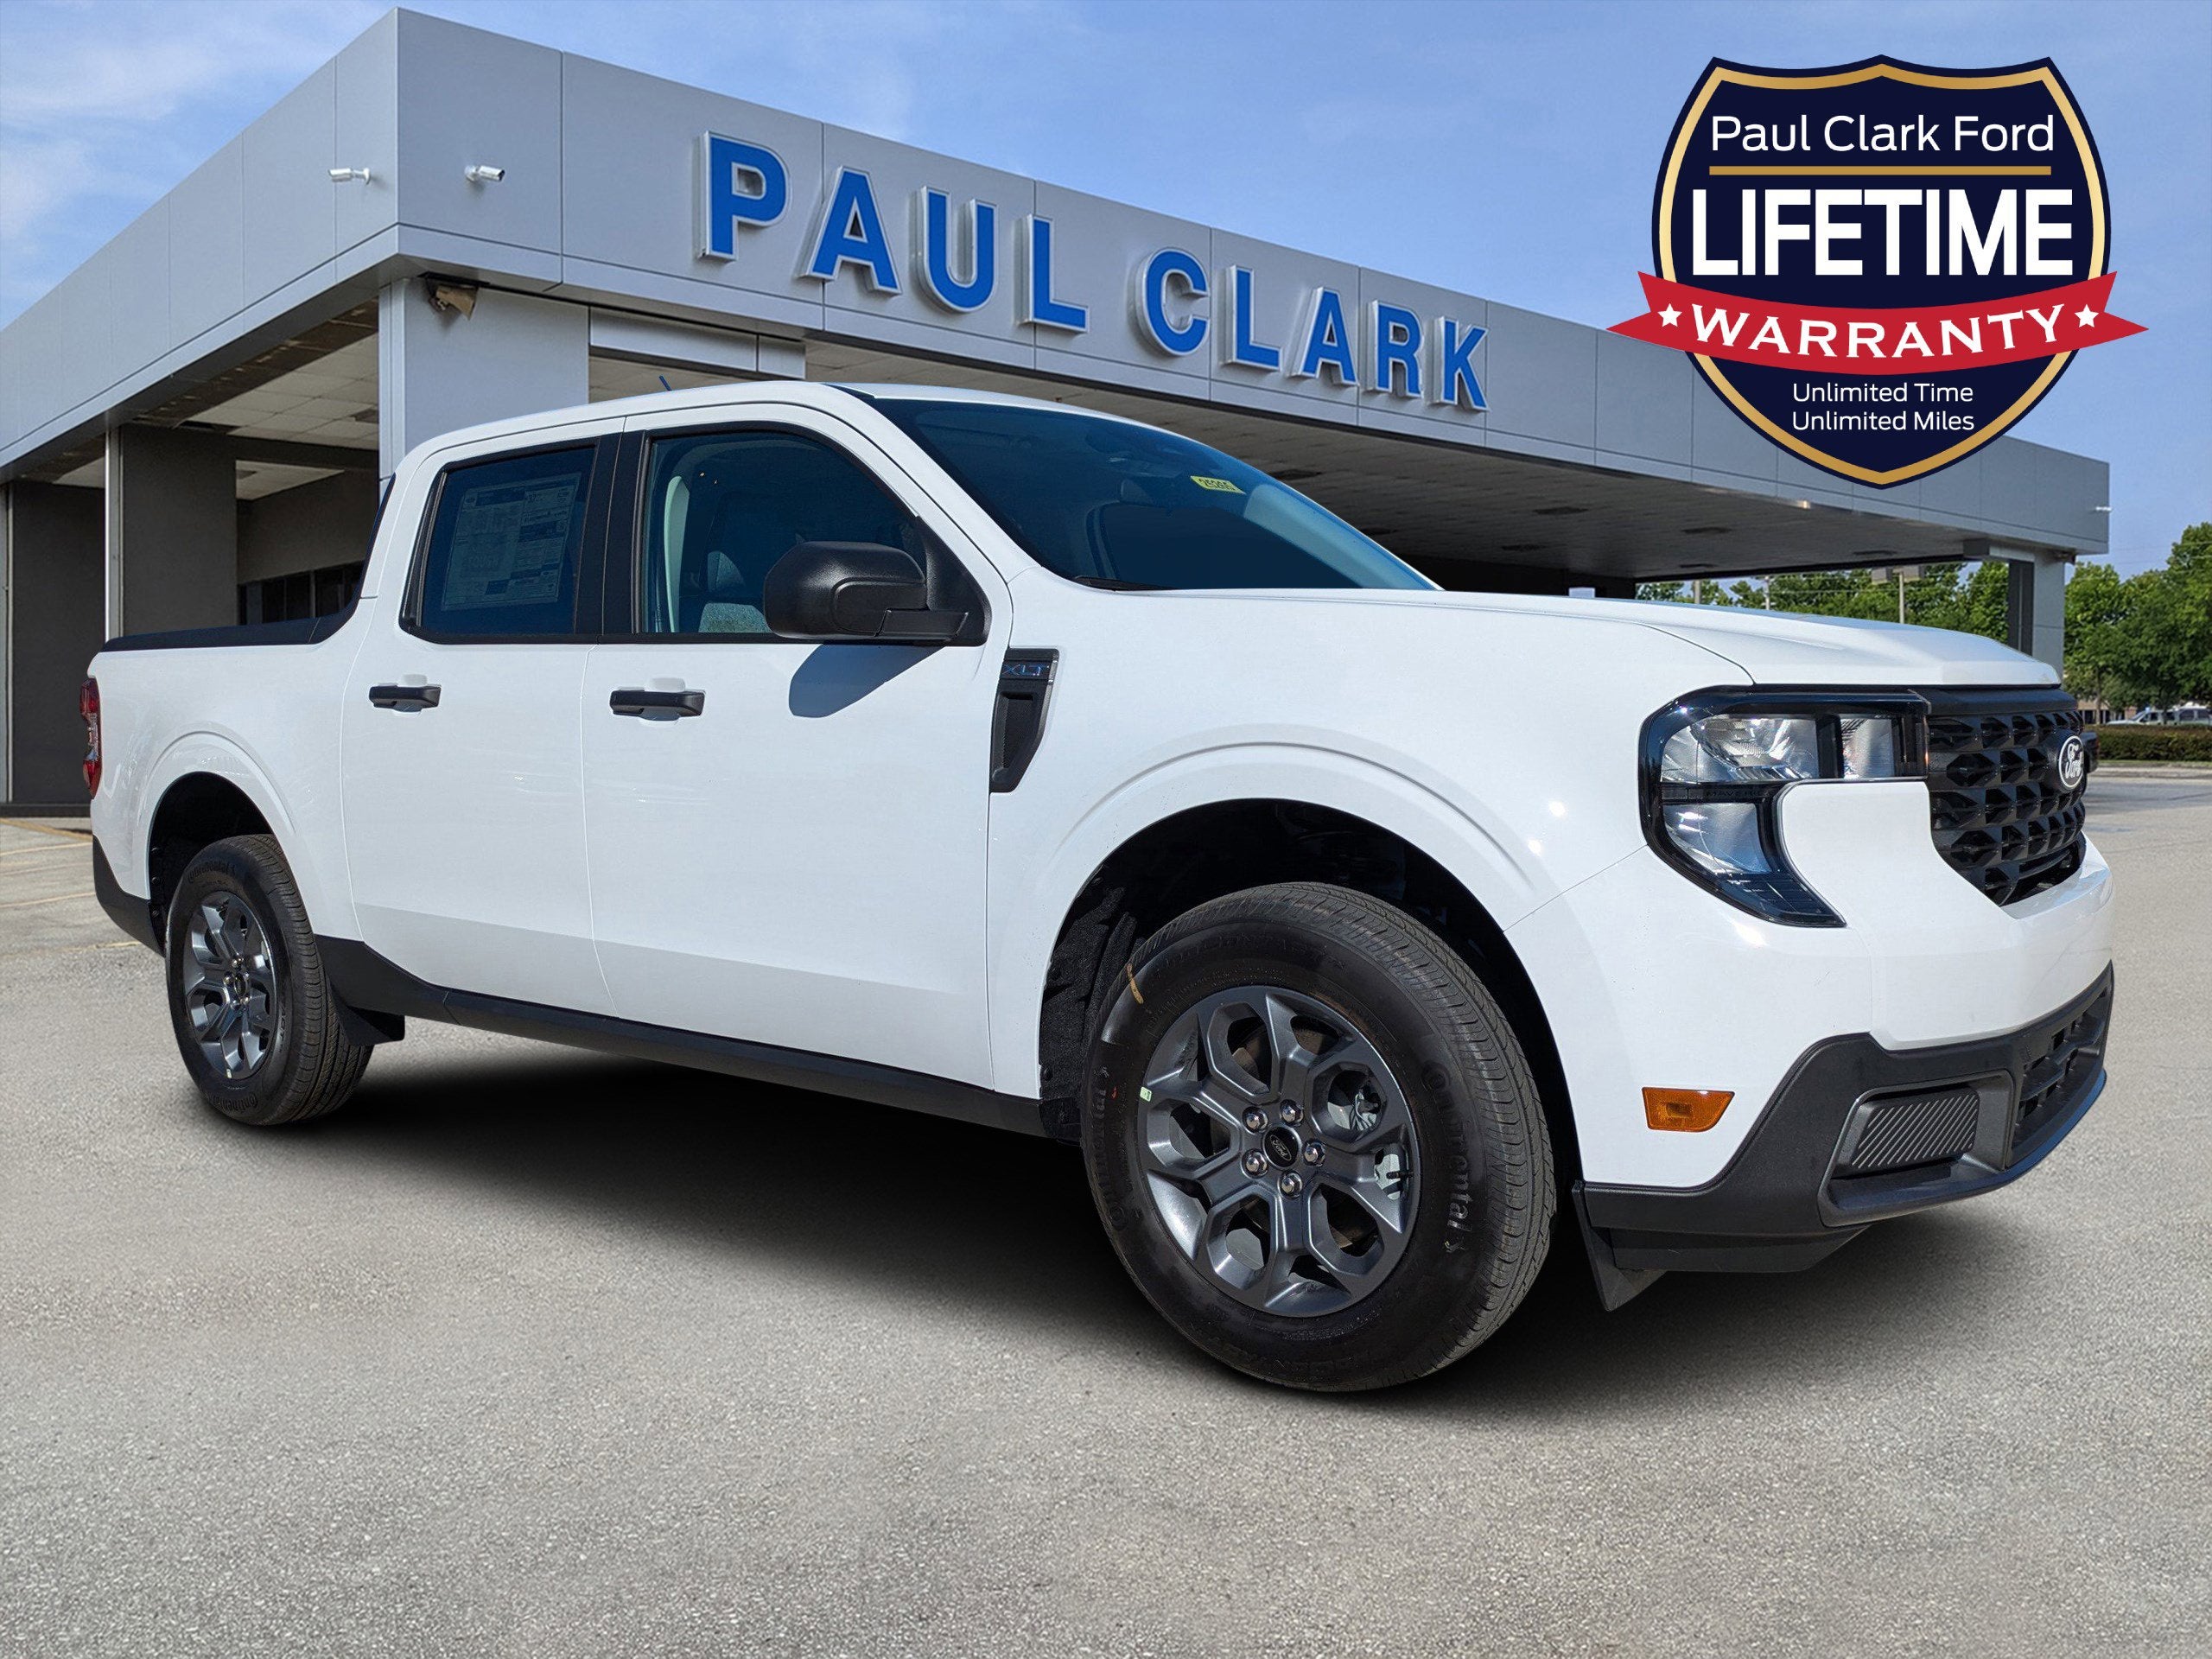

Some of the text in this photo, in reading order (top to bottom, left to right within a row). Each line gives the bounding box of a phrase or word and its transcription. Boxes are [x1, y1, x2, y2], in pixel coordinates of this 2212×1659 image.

[702, 130, 1489, 411] PAUL CLARK
[1001, 663, 1050, 677] XLT
[2063, 741, 2084, 780] Ford
